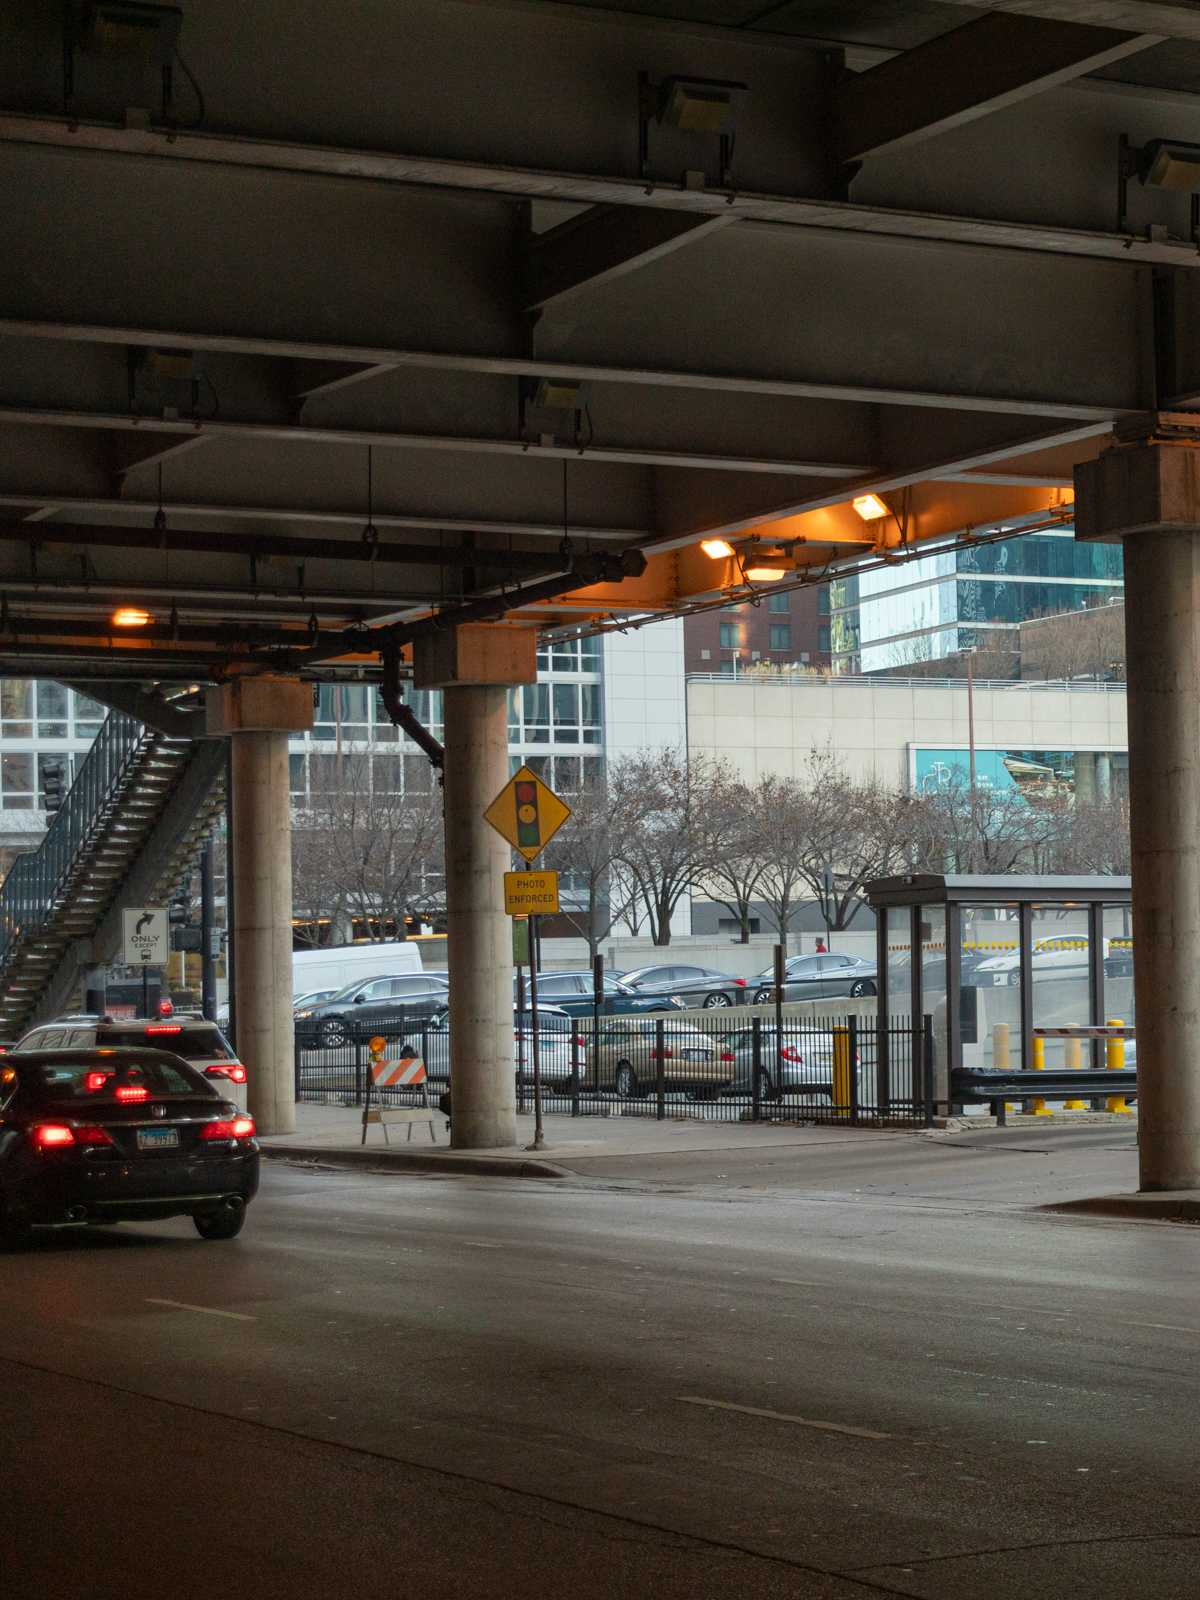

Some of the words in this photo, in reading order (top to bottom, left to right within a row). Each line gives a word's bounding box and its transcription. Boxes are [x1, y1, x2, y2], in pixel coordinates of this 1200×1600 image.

[516, 880, 545, 888] PHOTO
[508, 894, 554, 904] ENFORCED
[131, 935, 159, 943] ONLY
